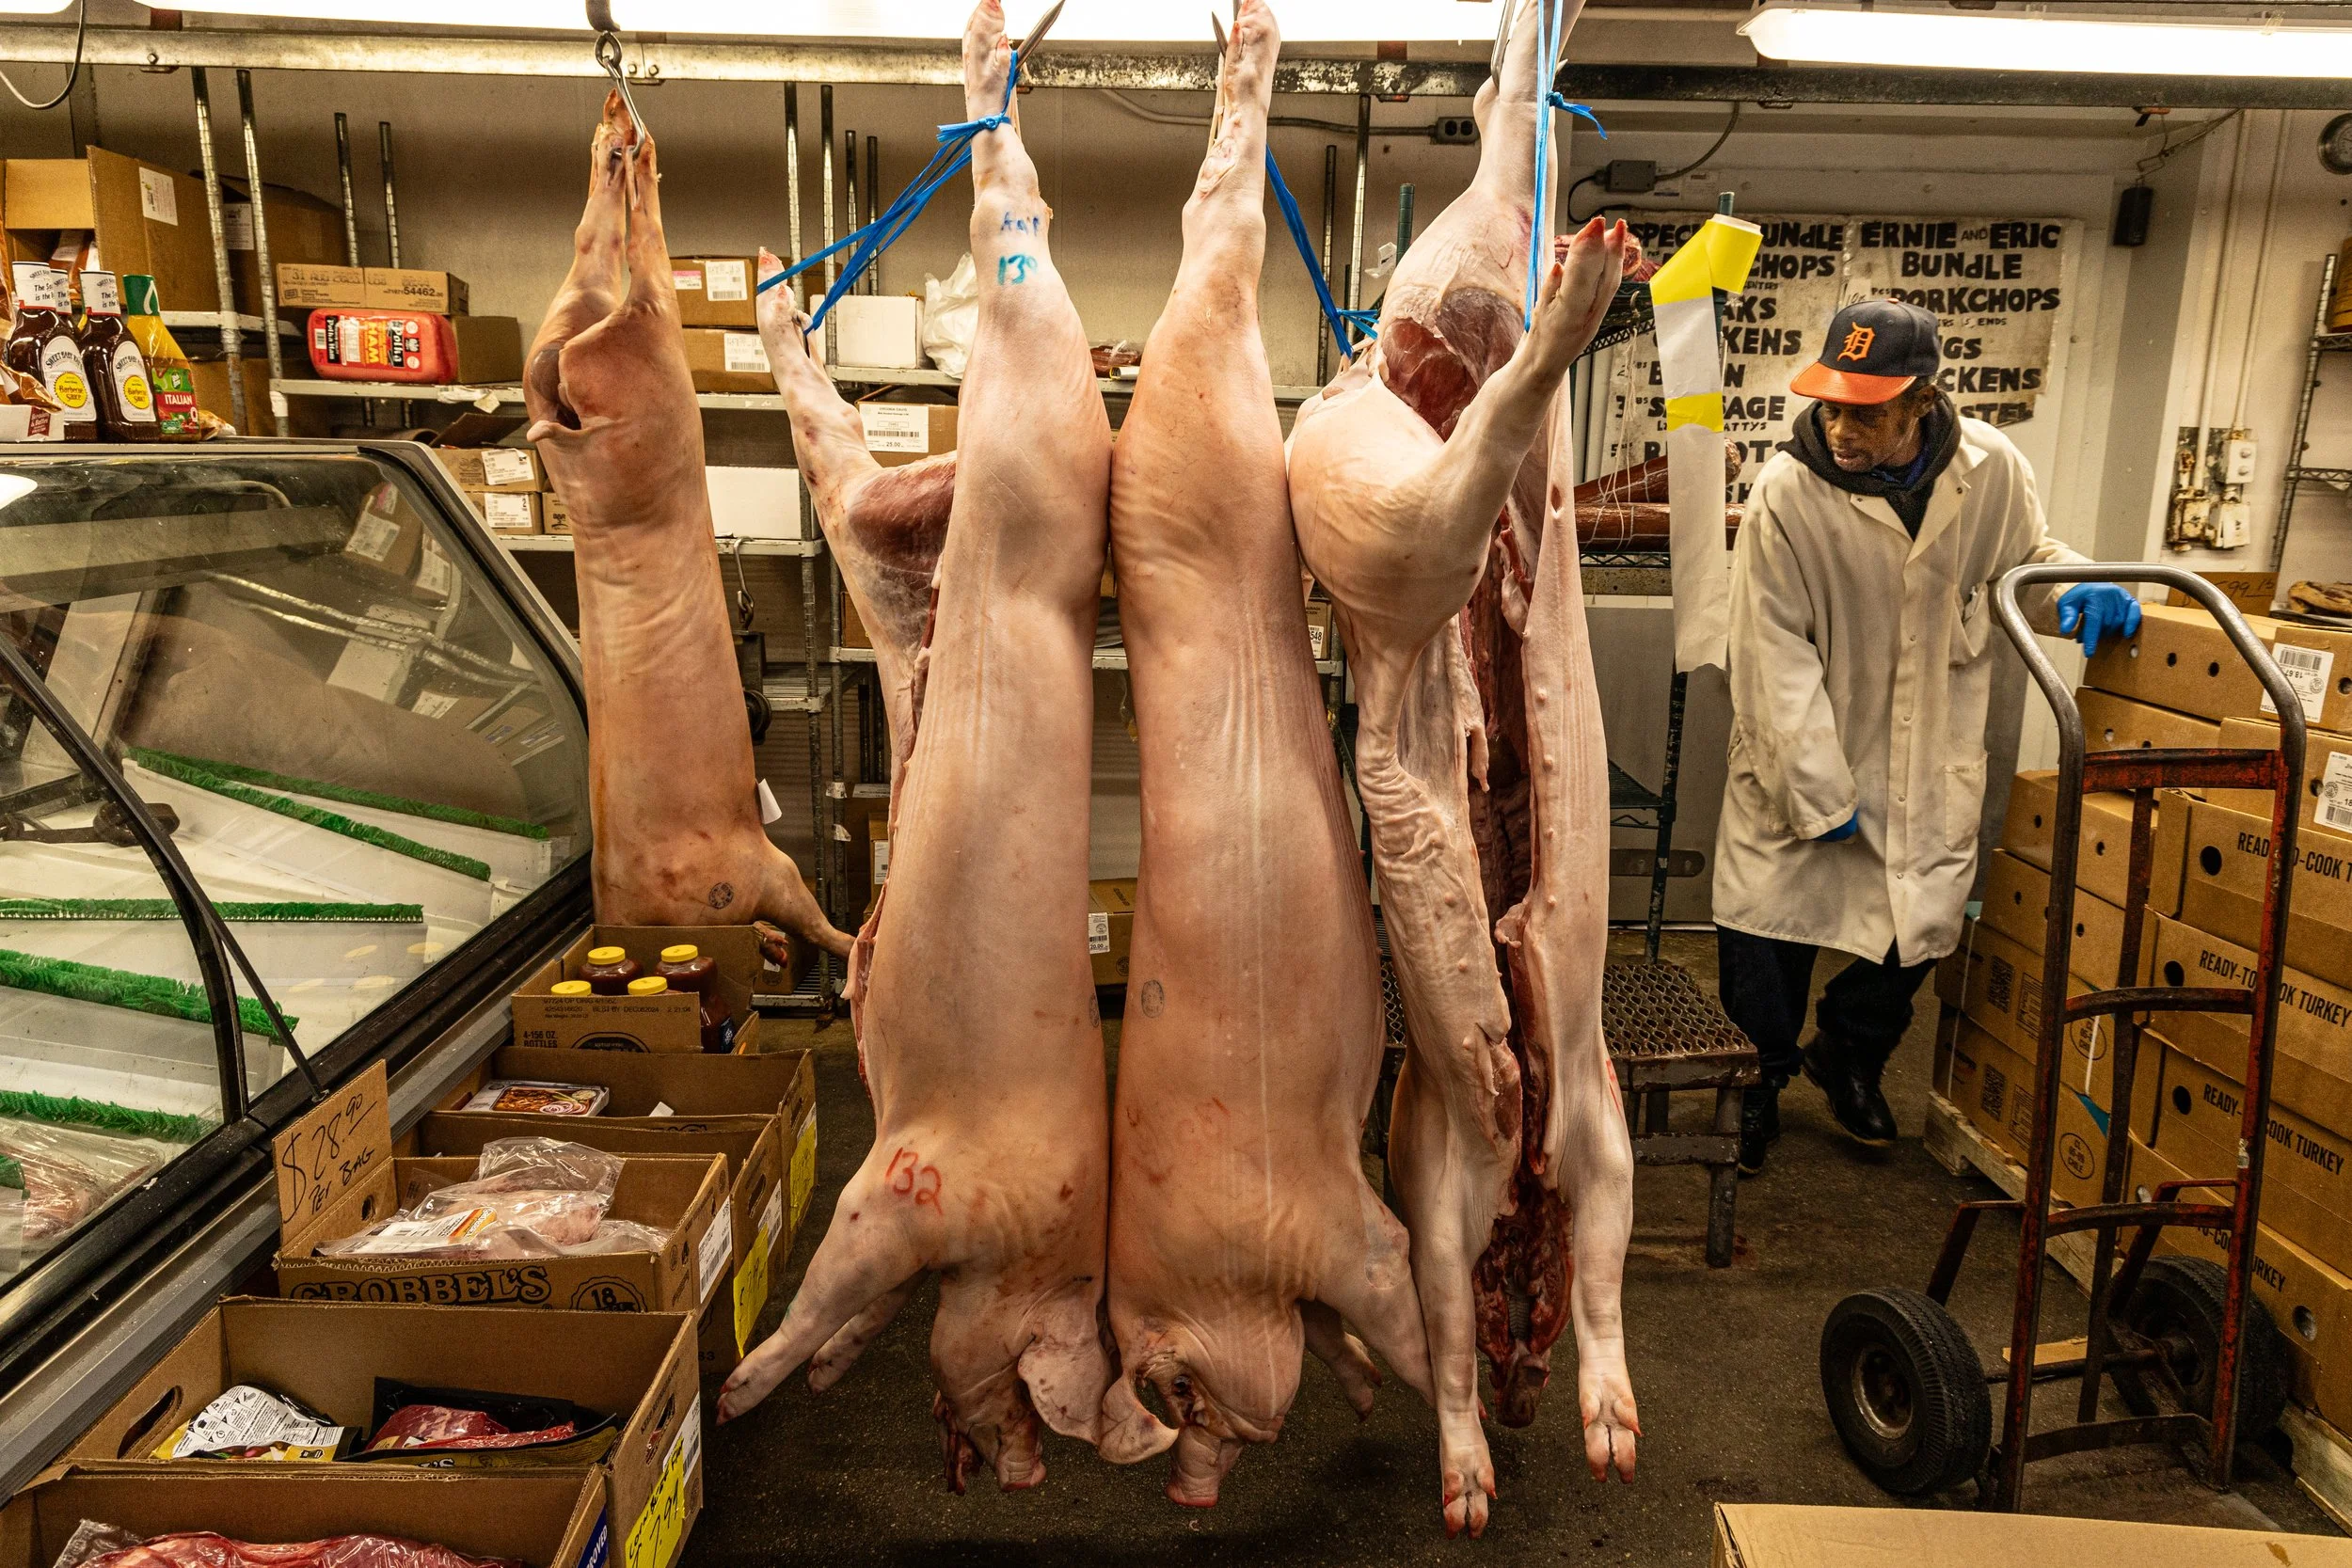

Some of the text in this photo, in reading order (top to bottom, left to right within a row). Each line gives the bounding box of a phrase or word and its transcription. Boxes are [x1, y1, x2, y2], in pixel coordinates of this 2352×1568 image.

[1629, 222, 1699, 248] SPEC
[1861, 221, 2062, 249] ERNIE AND ERIC
[1747, 253, 1836, 279] CHOPS
[1723, 295, 1777, 324] AKS
[1890, 287, 2060, 315] PORKCHOPS
[1978, 318, 2008, 326] ENDS
[367, 322, 380, 364] HAM
[1723, 325, 1803, 356] KENS
[1837, 321, 1876, 362] D
[1942, 336, 1982, 360] GS
[45, 352, 62, 370] SWEET
[1937, 365, 2042, 393] CKENS
[165, 394, 193, 405] ITALIAN
[1647, 396, 1787, 421] SAGE
[1724, 422, 1767, 432] ATTYS
[2237, 832, 2344, 880] READO-COOK
[2199, 949, 2352, 1028] READY-TOOK TURKEY
[523, 1039, 558, 1048] BOTTLES
[2203, 1084, 2344, 1176] READY-COOK TURKEY
[339, 1146, 375, 1187] BAG
[885, 1147, 944, 1216] 132
[290, 1265, 553, 1306] GROBBEL'S
[2253, 1255, 2287, 1293] URKEY
[590, 1288, 617, 1307] 18
